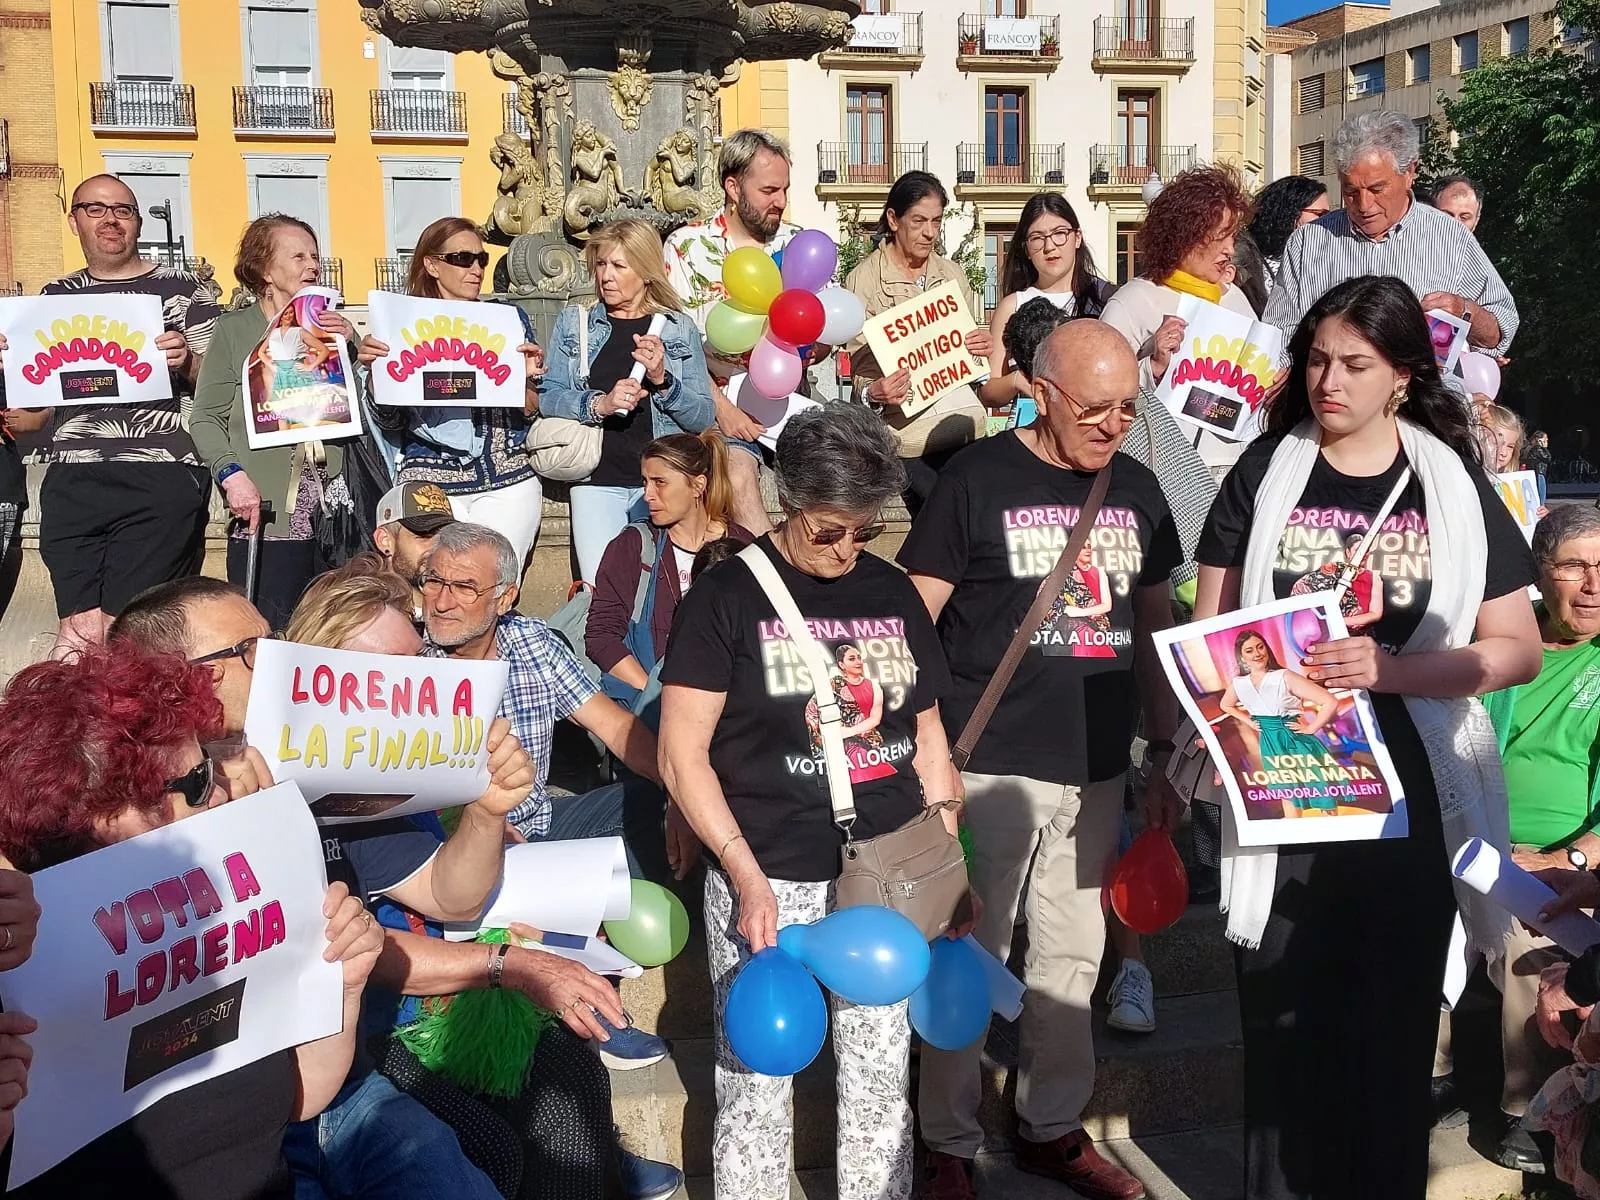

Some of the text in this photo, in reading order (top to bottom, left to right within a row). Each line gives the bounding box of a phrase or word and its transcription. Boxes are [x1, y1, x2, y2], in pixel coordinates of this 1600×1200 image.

[854, 31, 900, 45] RANCOY
[987, 33, 1038, 48] FRANCOY
[883, 294, 958, 344] ESTAMOS
[35, 314, 146, 353] LORENA
[401, 314, 506, 354] LORENA
[22, 337, 152, 385] GANADORA
[387, 337, 511, 386] GANADORA
[897, 329, 963, 372] CONTIGO
[917, 359, 971, 402] LORENA
[1171, 357, 1265, 413] GANADOR
[1004, 507, 1080, 529] LORENA
[1286, 508, 1370, 530] ORENA
[1008, 527, 1069, 551] FINA
[1281, 525, 1342, 549] INA
[1012, 551, 1060, 577] LIST
[1115, 574, 1129, 596] 3
[1391, 580, 1412, 606] 3
[760, 620, 851, 640] LOENA
[1029, 630, 1132, 647] OTA A LORENA
[291, 664, 473, 719] LORENA A
[889, 685, 906, 711] 3
[277, 714, 483, 772] LA FINAL!!!
[785, 756, 828, 776] VOT
[858, 735, 914, 769] LORENA
[1264, 752, 1339, 769] VOTA A
[1242, 765, 1377, 787] LORENA MATA
[1247, 783, 1384, 801] GANADORA JOTALENT
[92, 851, 262, 956] VOTA A
[104, 899, 286, 1021] LORENA
[163, 1033, 200, 1057] 2024
